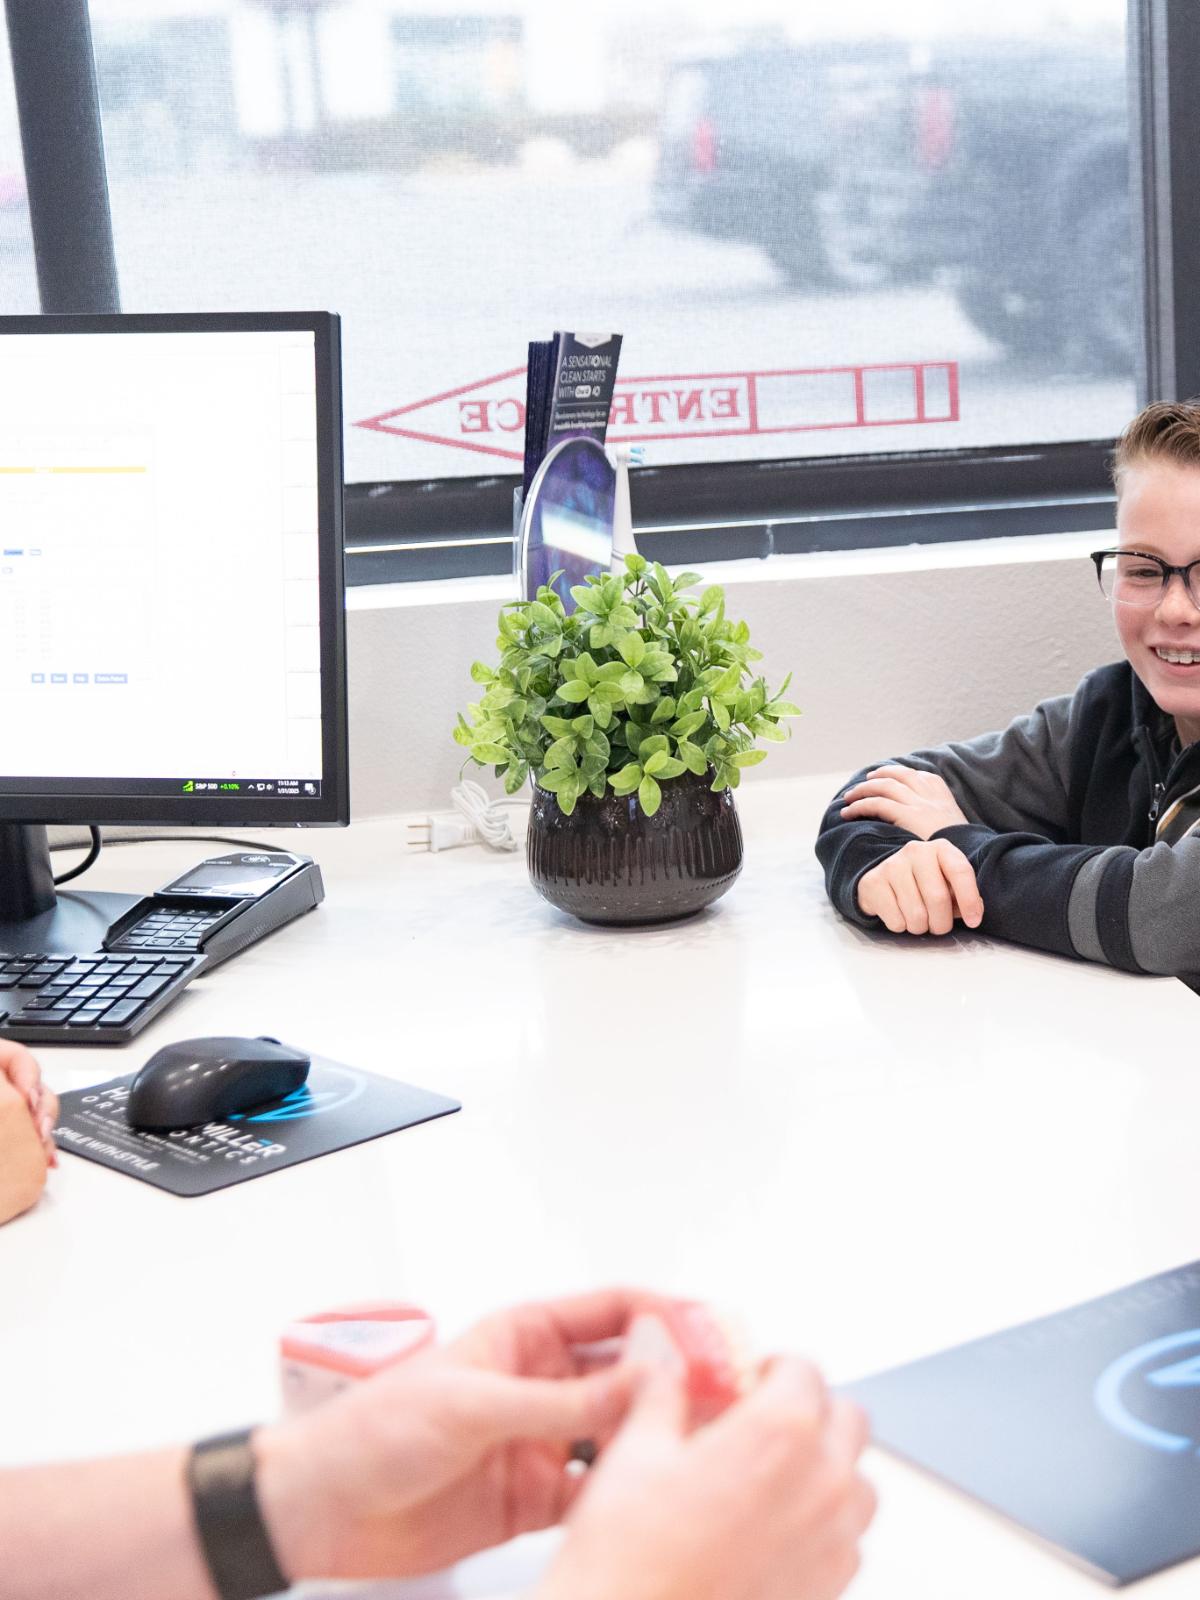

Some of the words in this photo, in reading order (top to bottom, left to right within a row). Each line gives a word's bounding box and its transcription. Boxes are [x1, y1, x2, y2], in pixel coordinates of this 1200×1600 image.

[560, 371, 582, 384] CLEAN
[582, 370, 607, 383] STARTS
[558, 386, 575, 398] WITH
[193, 1122, 287, 1158] MILLER
[85, 1140, 122, 1156] WITH
[113, 1152, 161, 1170] STYLE
